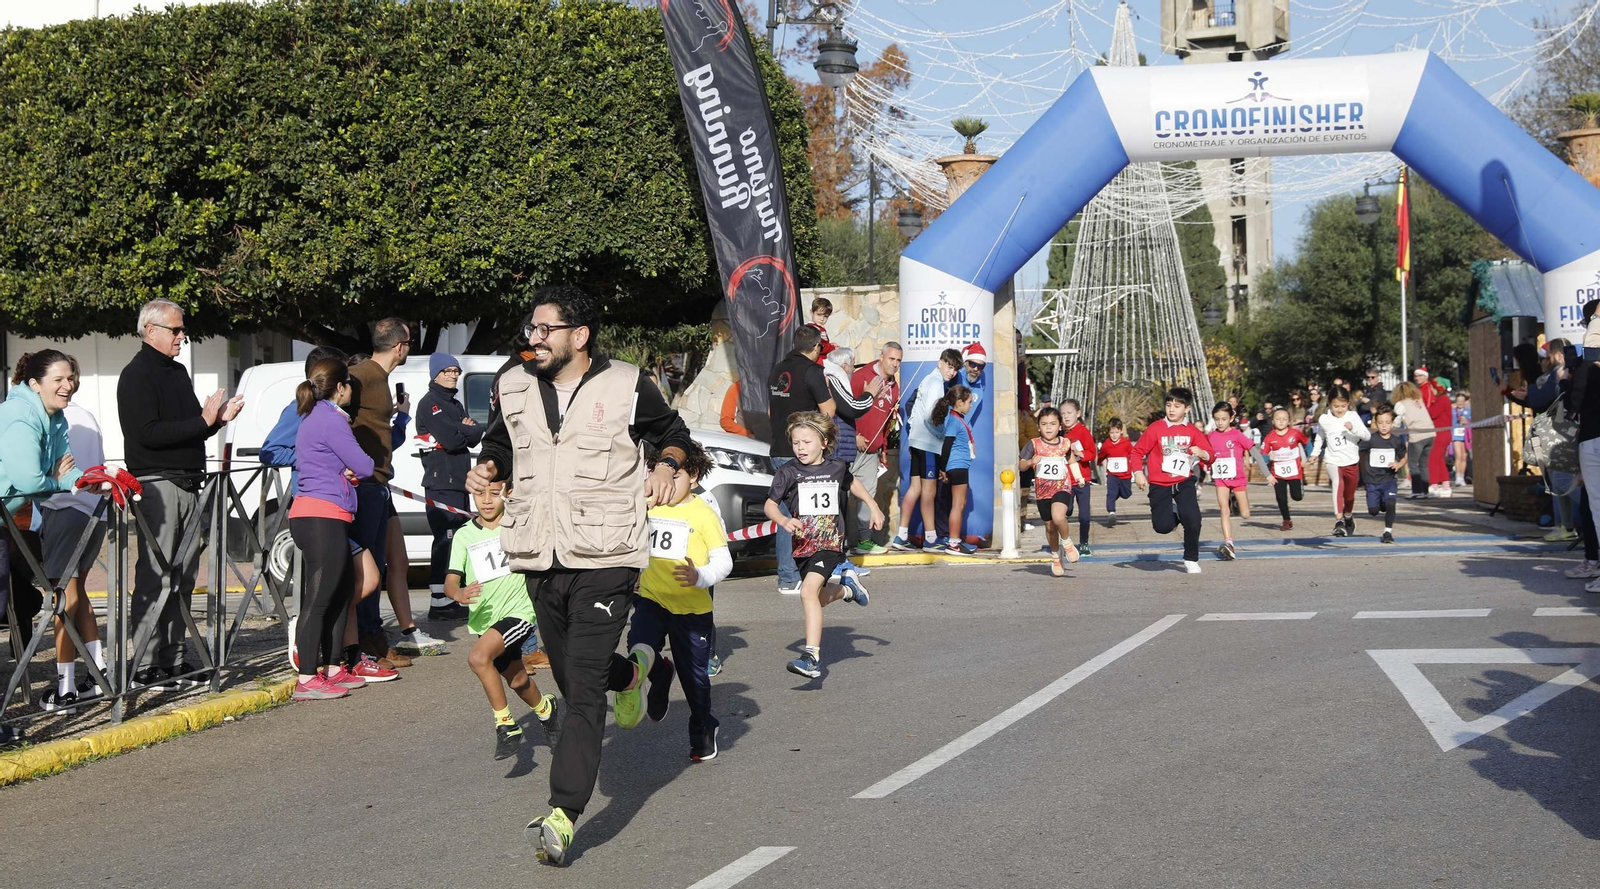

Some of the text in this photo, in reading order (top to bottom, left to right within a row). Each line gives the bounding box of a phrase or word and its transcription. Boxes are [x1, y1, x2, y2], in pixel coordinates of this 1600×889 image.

[1155, 102, 1364, 139] CRONOFINISHER
[1153, 139, 1226, 149] CRONOMETRAJE
[1238, 136, 1306, 145] ORGANIZACIÓN
[1309, 135, 1321, 143] DE
[1324, 133, 1367, 142] EVENTOS
[921, 308, 966, 323] CRONO
[908, 323, 981, 345] FINISHER
[1335, 436, 1347, 447] 31
[1114, 462, 1119, 470] 8
[1172, 459, 1186, 471] 17
[1379, 455, 1386, 464] 9
[1043, 463, 1059, 475] 26
[1216, 464, 1228, 474] 32
[1281, 466, 1291, 474] 30
[811, 493, 830, 508] 13
[650, 529, 673, 550] 18
[485, 549, 510, 570] 12
